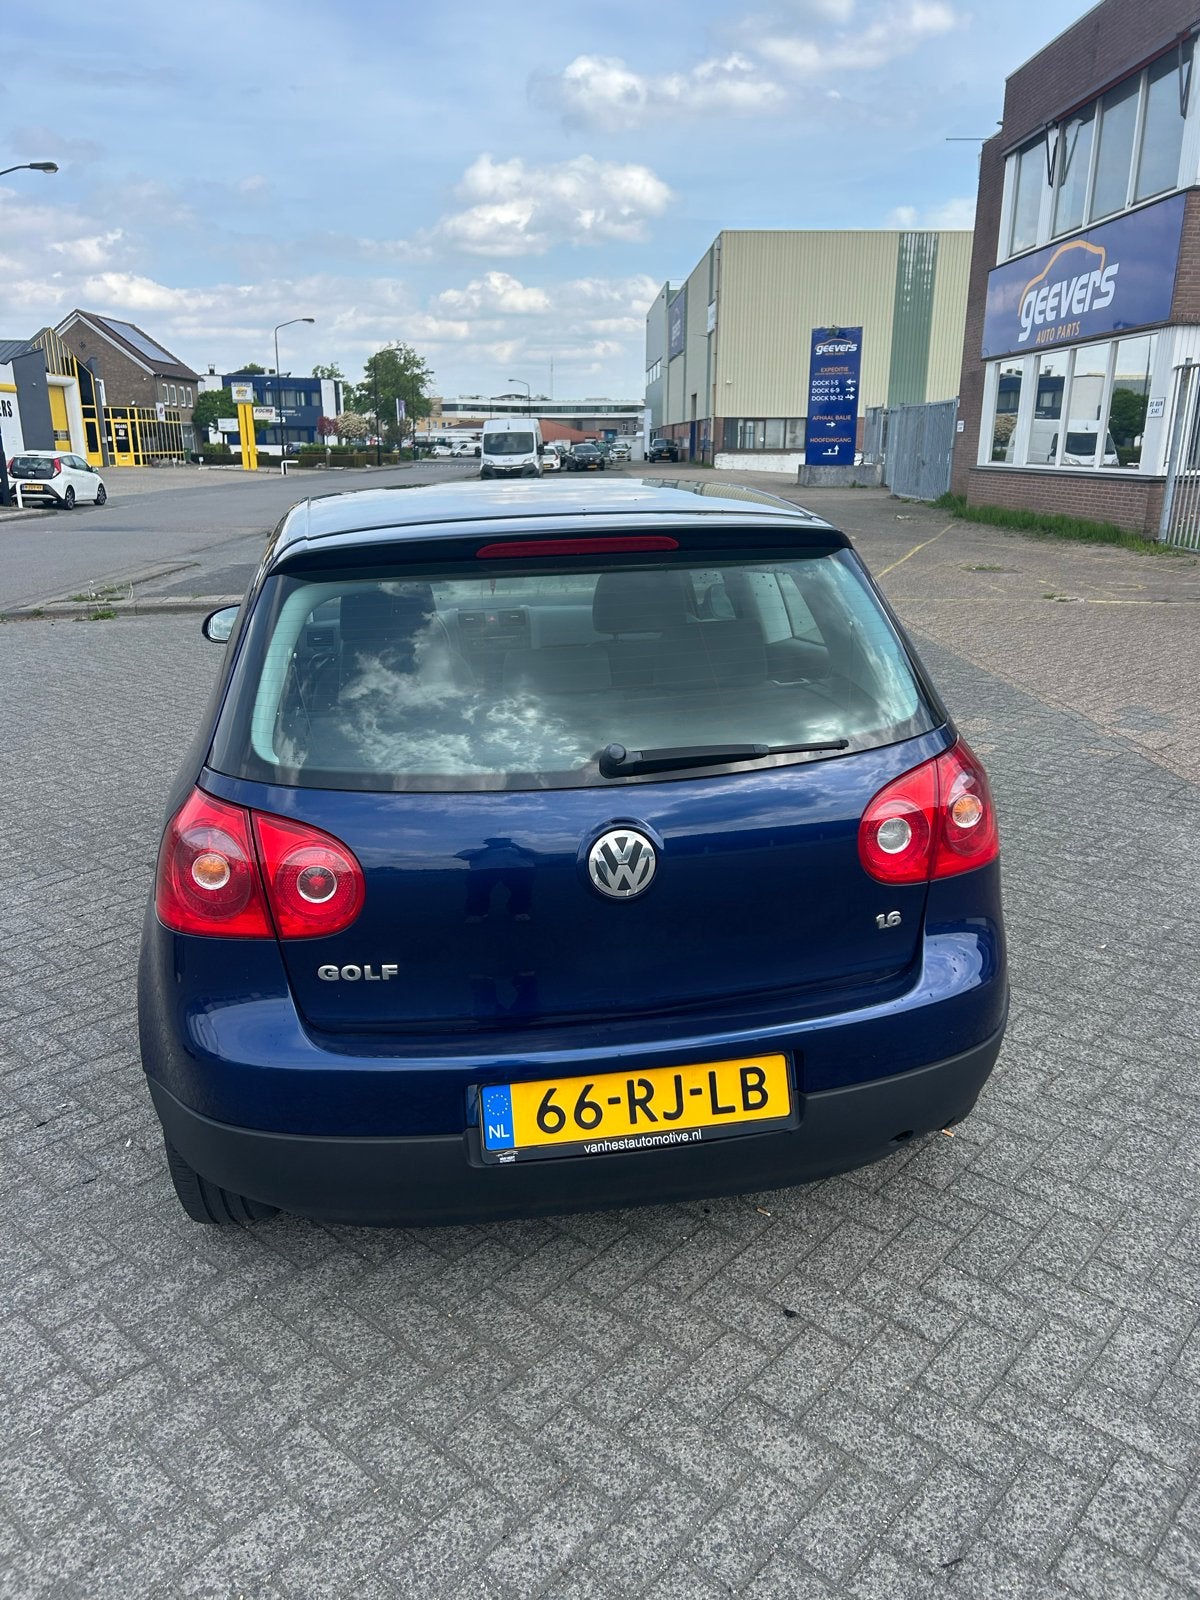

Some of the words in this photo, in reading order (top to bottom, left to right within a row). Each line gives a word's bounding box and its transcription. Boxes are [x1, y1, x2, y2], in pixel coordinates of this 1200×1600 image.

[1036, 327, 1055, 344] AUTO
[1056, 320, 1080, 340] PARTS
[317, 964, 399, 981] GOLF
[536, 1065, 770, 1135] 66-RJ-LB
[488, 1123, 510, 1139] NL
[583, 1128, 702, 1154] vanhestautomotive.nl
